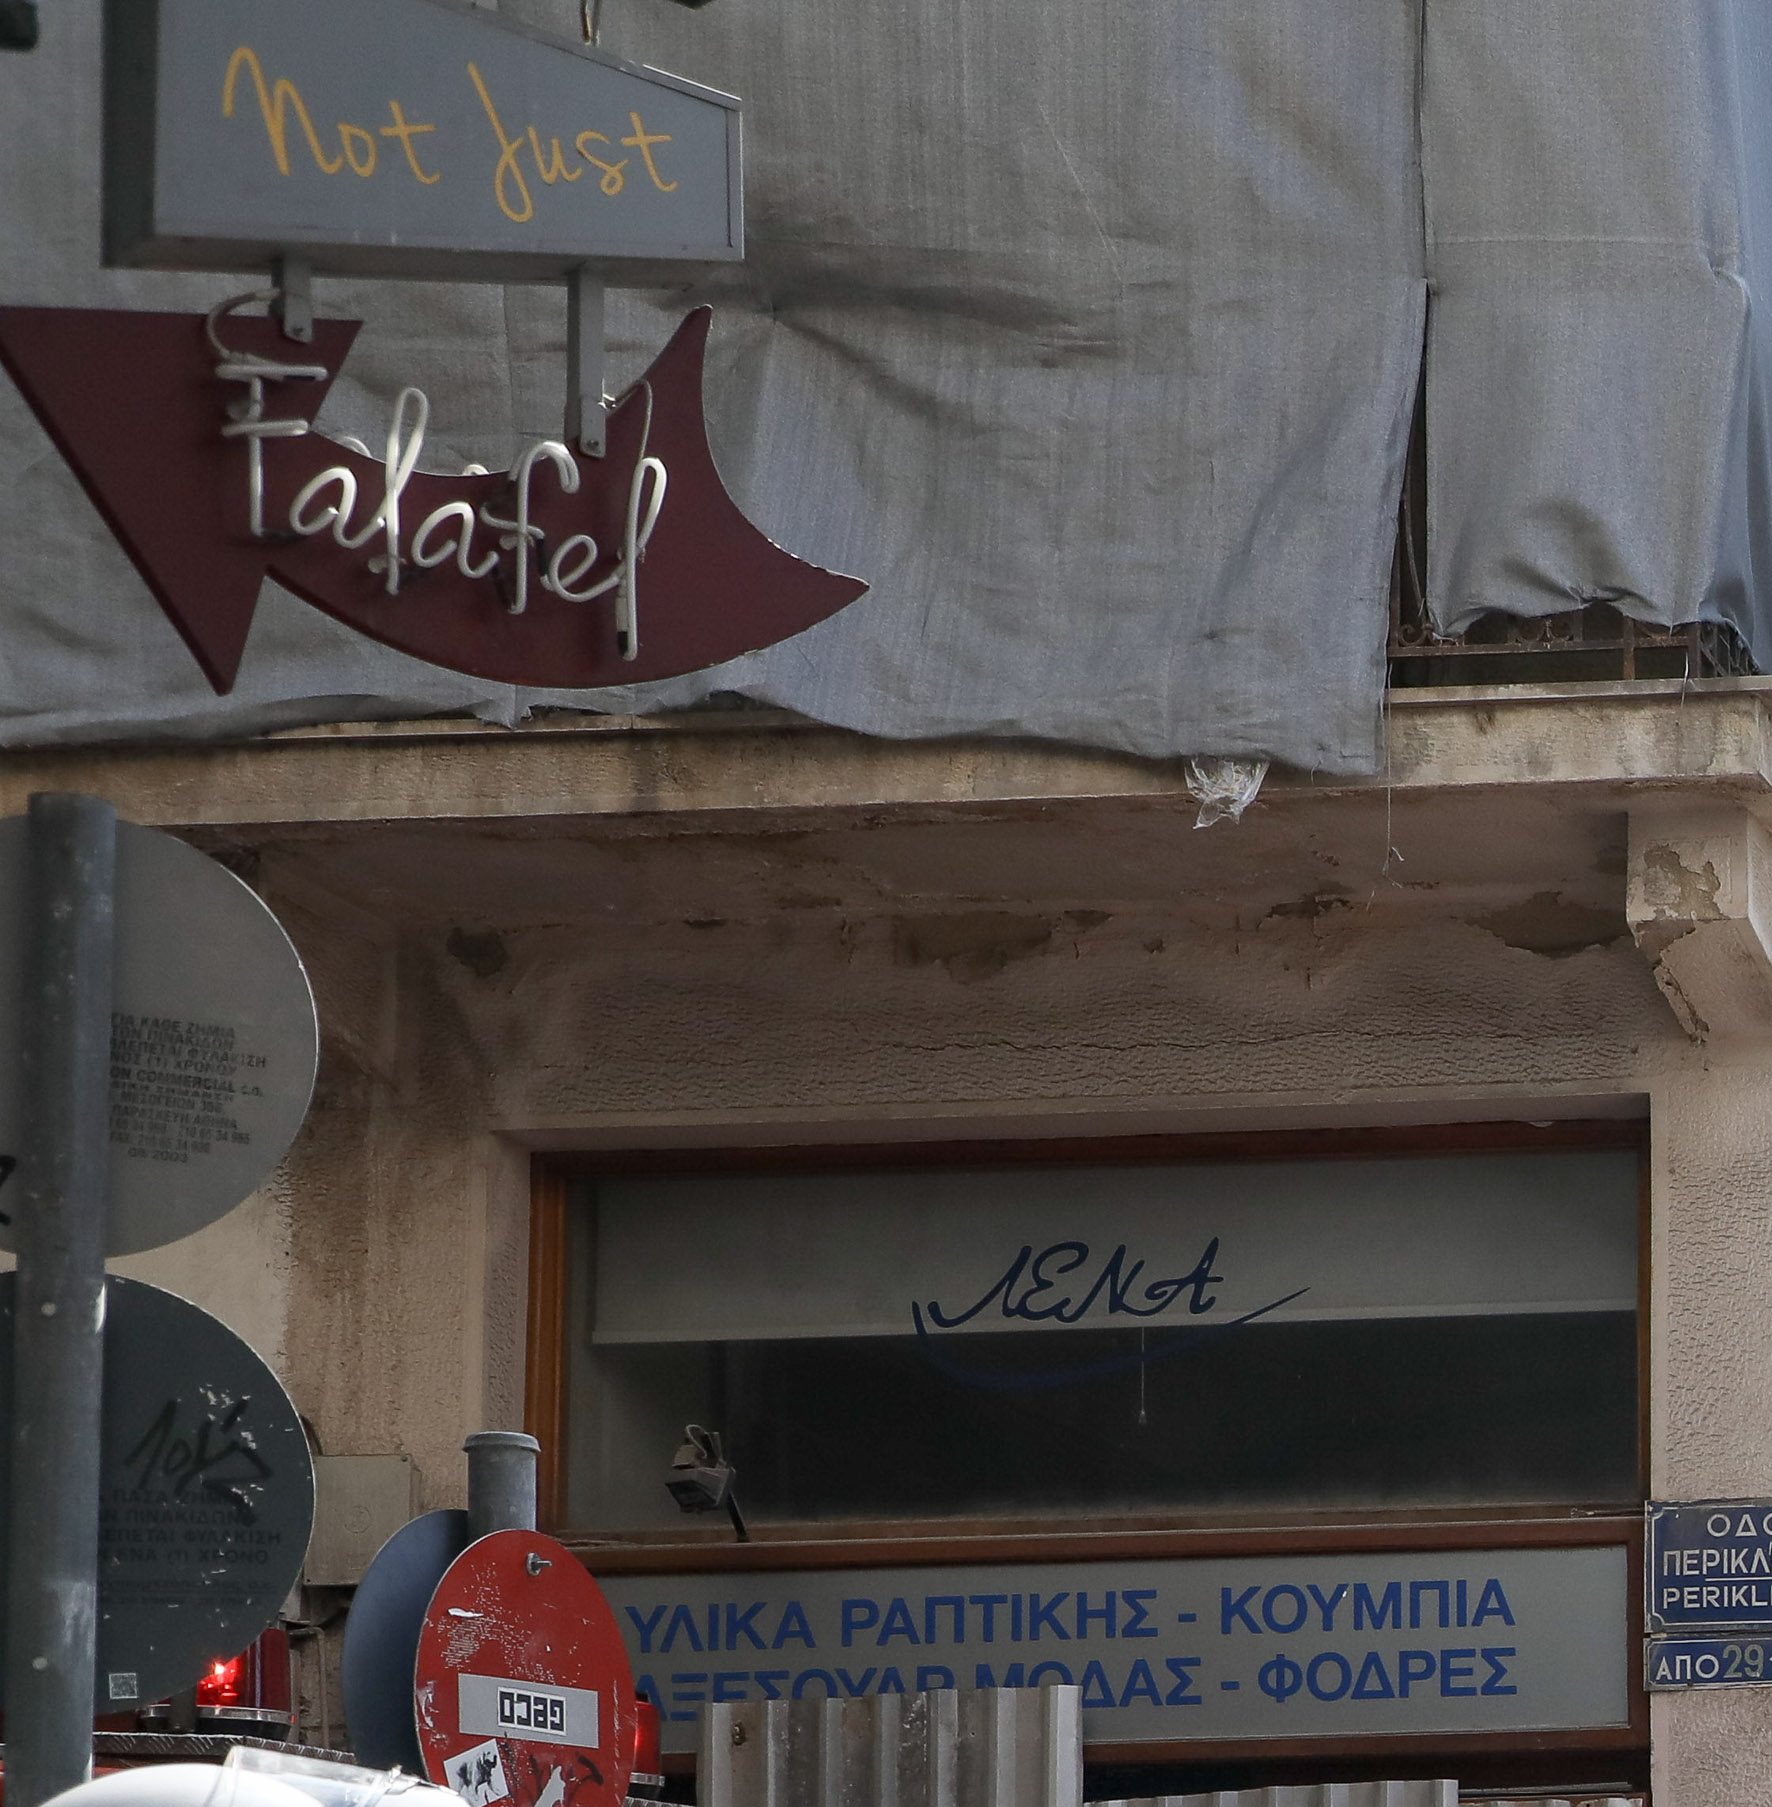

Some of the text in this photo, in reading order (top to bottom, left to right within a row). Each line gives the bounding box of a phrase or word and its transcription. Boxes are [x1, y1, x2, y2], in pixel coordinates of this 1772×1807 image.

[222, 46, 678, 223] Not Just
[213, 364, 667, 661] Falafel
[625, 1601, 816, 1654] ΥΛΙΚΑ
[841, 1589, 1158, 1647] ΡΑΠΤΙΚΗΣ
[1220, 1578, 1516, 1635] ΚΟΥΜΠΙΑ
[1258, 1647, 1518, 1703] ΦΟΔΡΕΣ
[1655, 1653, 1720, 1681] ΑΠΟ
[1722, 1643, 1765, 1679] 29
